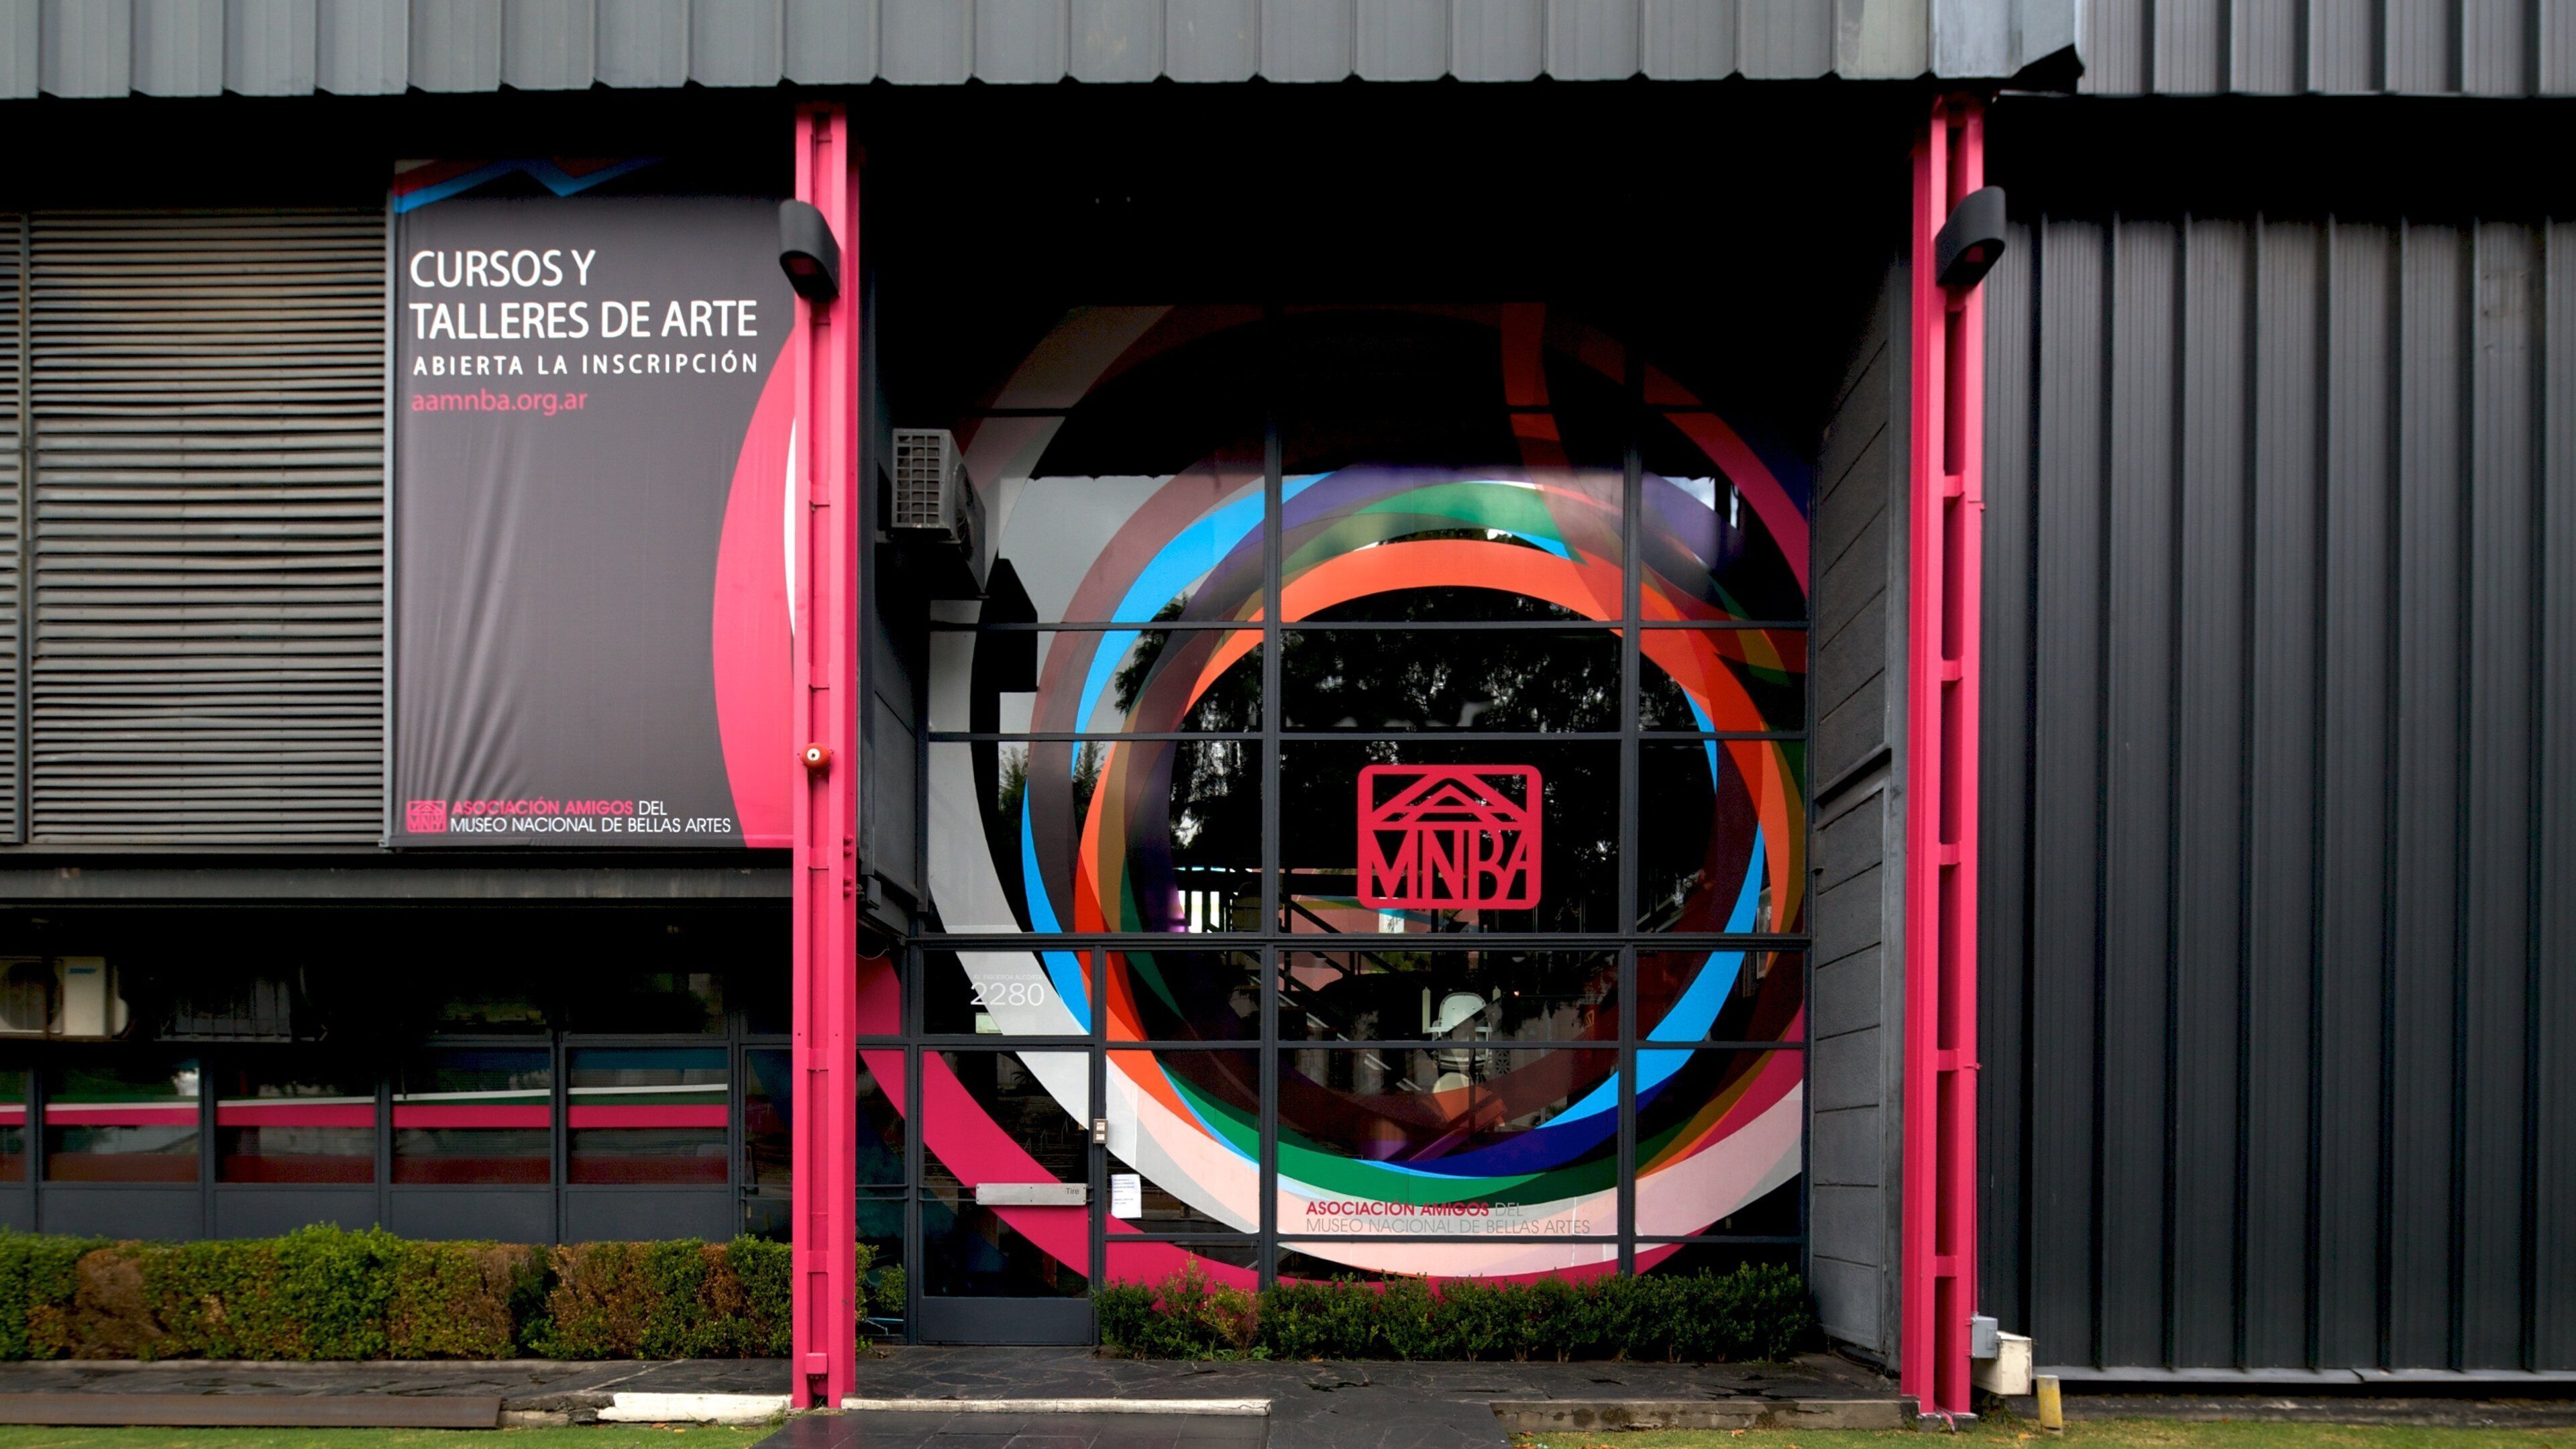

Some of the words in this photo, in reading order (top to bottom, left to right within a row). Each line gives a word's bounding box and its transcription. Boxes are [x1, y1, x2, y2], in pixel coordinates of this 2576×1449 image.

[410, 250, 563, 288] CURSOS
[571, 250, 596, 286] Y
[409, 301, 589, 339] TALLERES
[601, 301, 651, 338] DE
[661, 300, 757, 337] ARTE
[413, 355, 523, 376] ABIERTA
[537, 355, 568, 375] LA
[582, 349, 757, 374] INSCRIPCIÓN
[411, 388, 587, 416] aamnba.org.ar
[451, 797, 559, 815] ASOCIACIÓN
[564, 800, 633, 816] AMIGOS
[639, 800, 667, 816] DEL
[450, 816, 507, 833] MUSEO
[512, 816, 596, 833] NACIONAL
[601, 817, 623, 833] DE
[628, 817, 681, 833] BELLAS
[685, 818, 731, 833] ARTES
[1358, 826, 1542, 909] MNBA
[970, 982, 1044, 1006] 2280
[1066, 1187, 1080, 1195] Tire
[1306, 1199, 1415, 1216] ASOCIACIÓN
[1420, 1202, 1489, 1217] AMIGOS
[1495, 1202, 1523, 1217] DEL
[1306, 1218, 1363, 1233] MUSEO
[1368, 1218, 1454, 1233] NACIONAL
[1460, 1220, 1480, 1234] DE
[1487, 1220, 1540, 1234] BELLAS
[1544, 1220, 1591, 1234] ARTES
